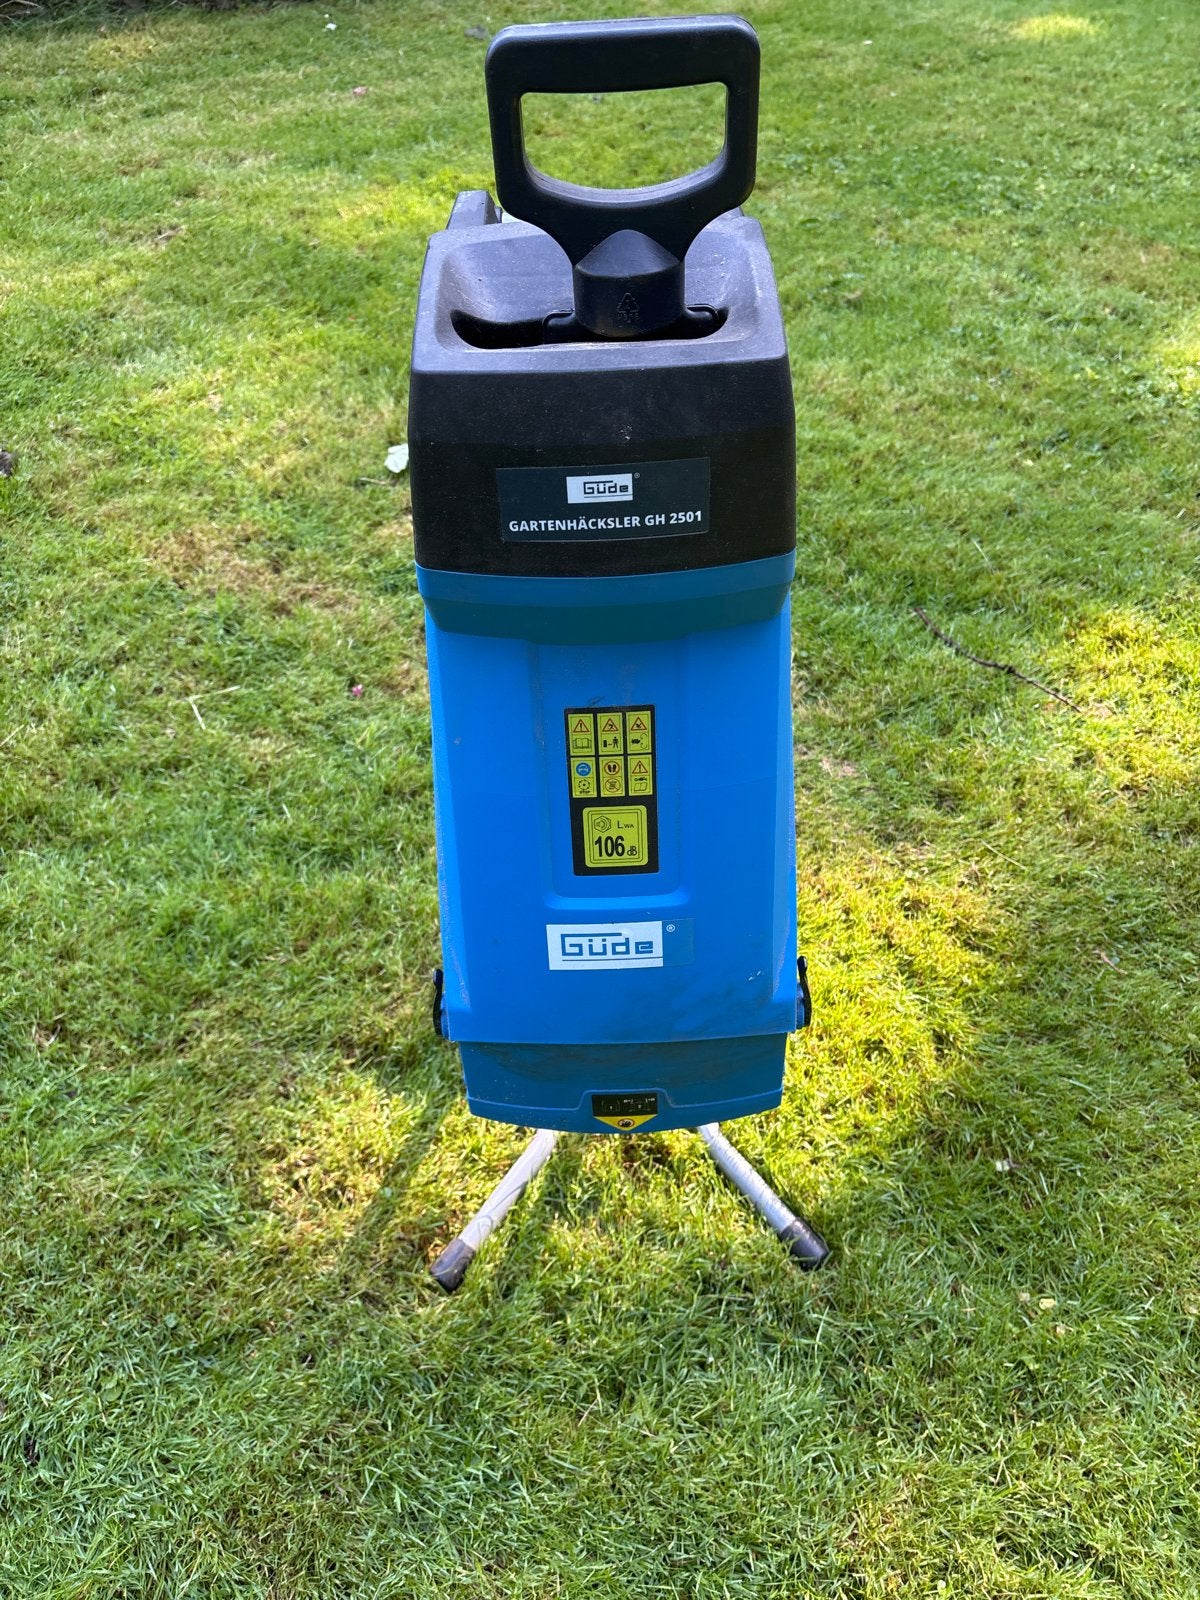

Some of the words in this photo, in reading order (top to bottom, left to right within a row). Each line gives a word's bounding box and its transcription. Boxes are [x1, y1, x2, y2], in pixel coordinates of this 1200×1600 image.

[583, 480, 630, 495] Güde
[508, 515, 641, 533] GARTENHÄCKSLER
[644, 513, 666, 527] GH
[669, 510, 702, 525] 2501
[594, 835, 626, 858] 106
[560, 932, 654, 957] Güde
